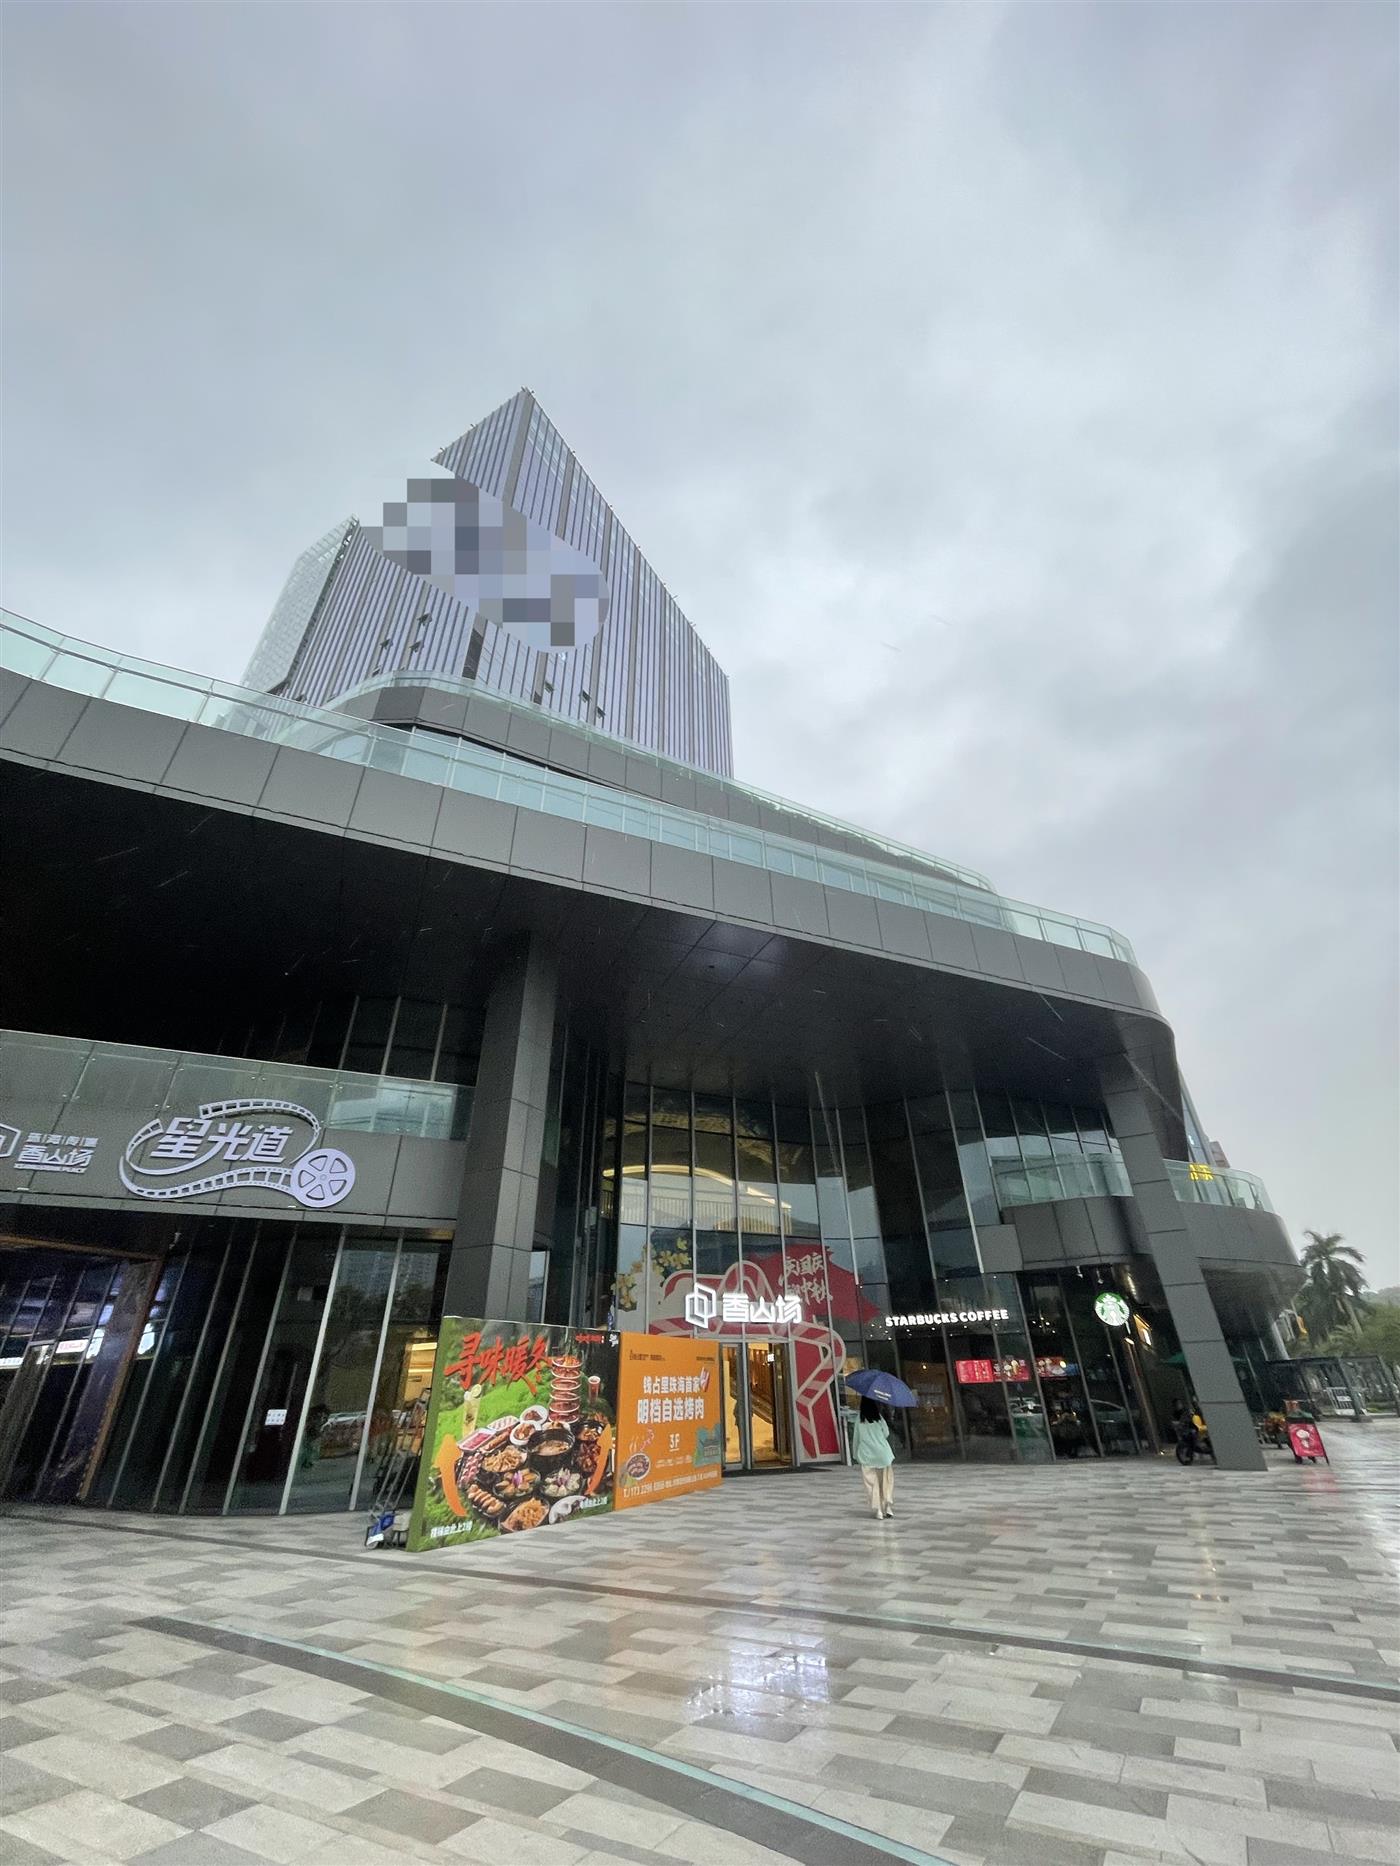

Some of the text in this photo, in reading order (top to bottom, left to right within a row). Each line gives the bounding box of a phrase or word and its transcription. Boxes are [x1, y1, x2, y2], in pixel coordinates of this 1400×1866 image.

[150, 1117, 293, 1163] 星光道
[18, 1144, 95, 1167] 香山场
[722, 1292, 802, 1324] 香山场
[885, 1309, 1009, 1327] STARBUCKS COFFEE
[444, 1332, 553, 1397] 寻味暖冬
[637, 1396, 705, 1424] 明档自选烤肉
[669, 1433, 680, 1450] 3F
